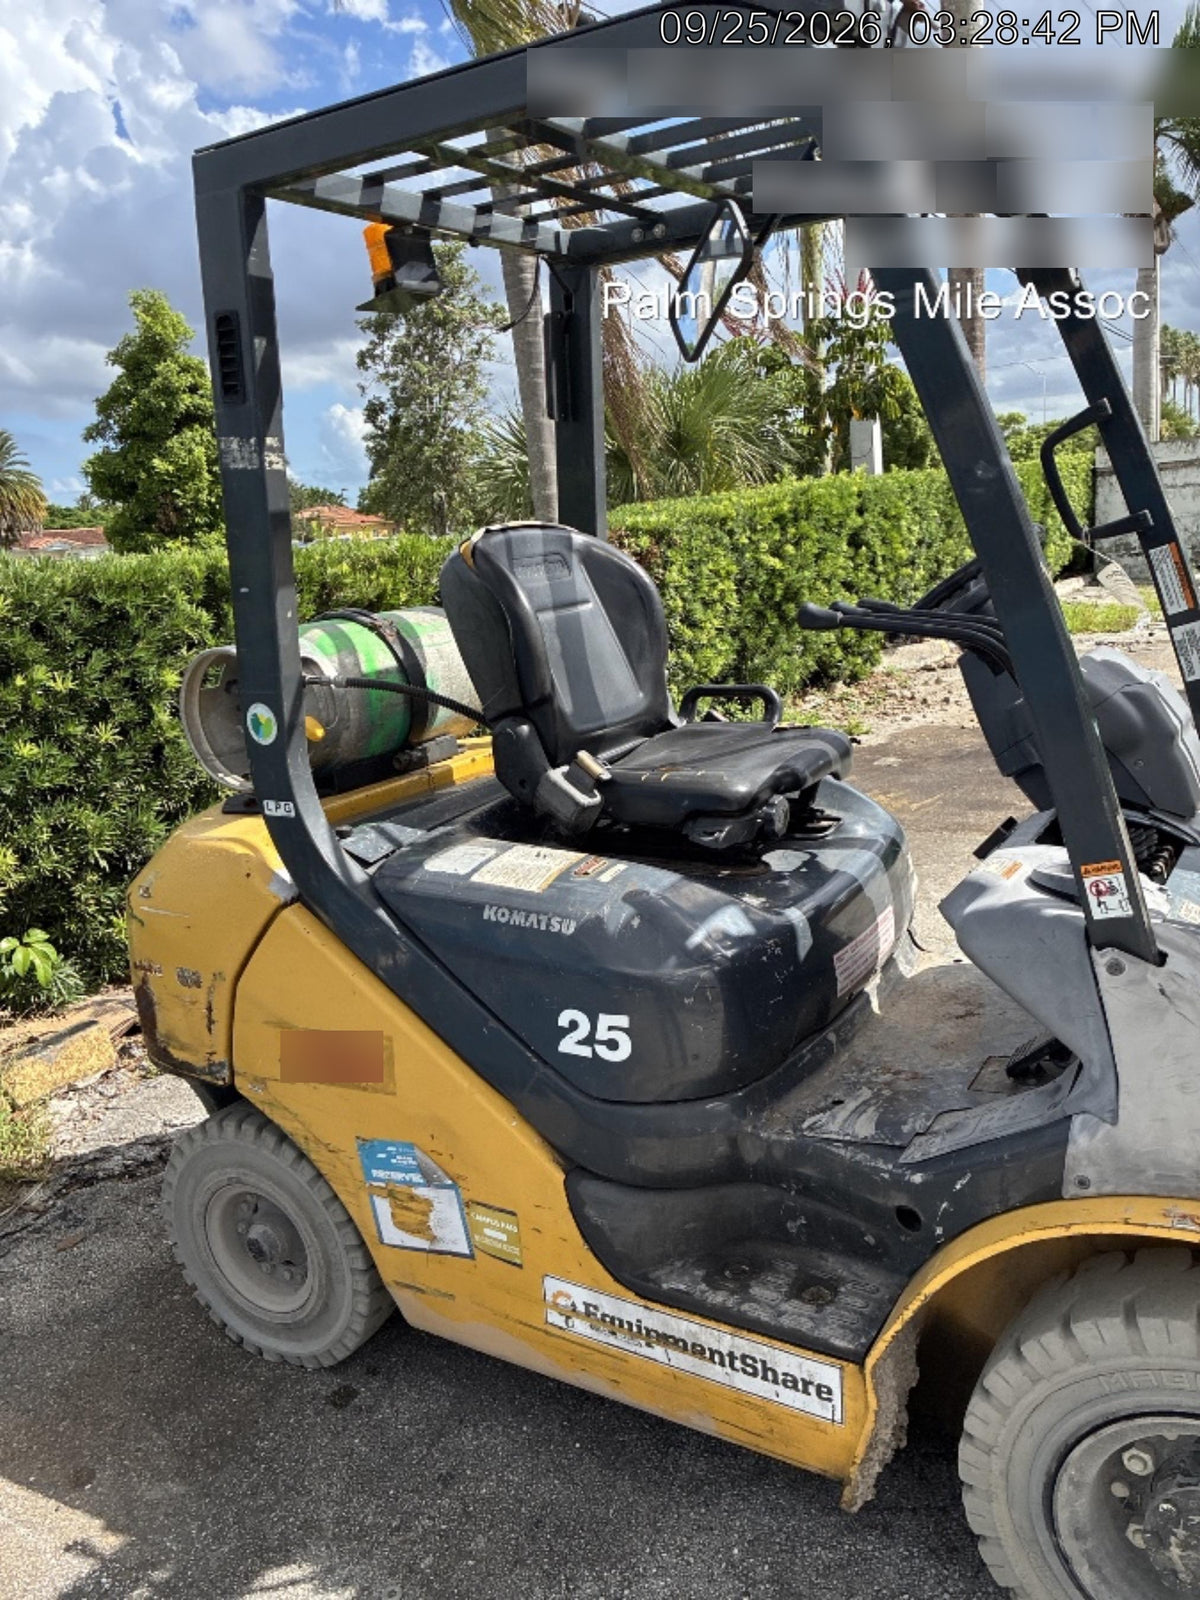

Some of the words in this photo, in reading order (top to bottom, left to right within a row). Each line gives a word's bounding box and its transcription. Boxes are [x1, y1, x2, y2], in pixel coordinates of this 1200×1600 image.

[266, 802, 292, 813] LPG
[483, 905, 577, 935] KOMATSU
[557, 1007, 633, 1062] 25
[582, 1300, 834, 1404] EquipmentShare
